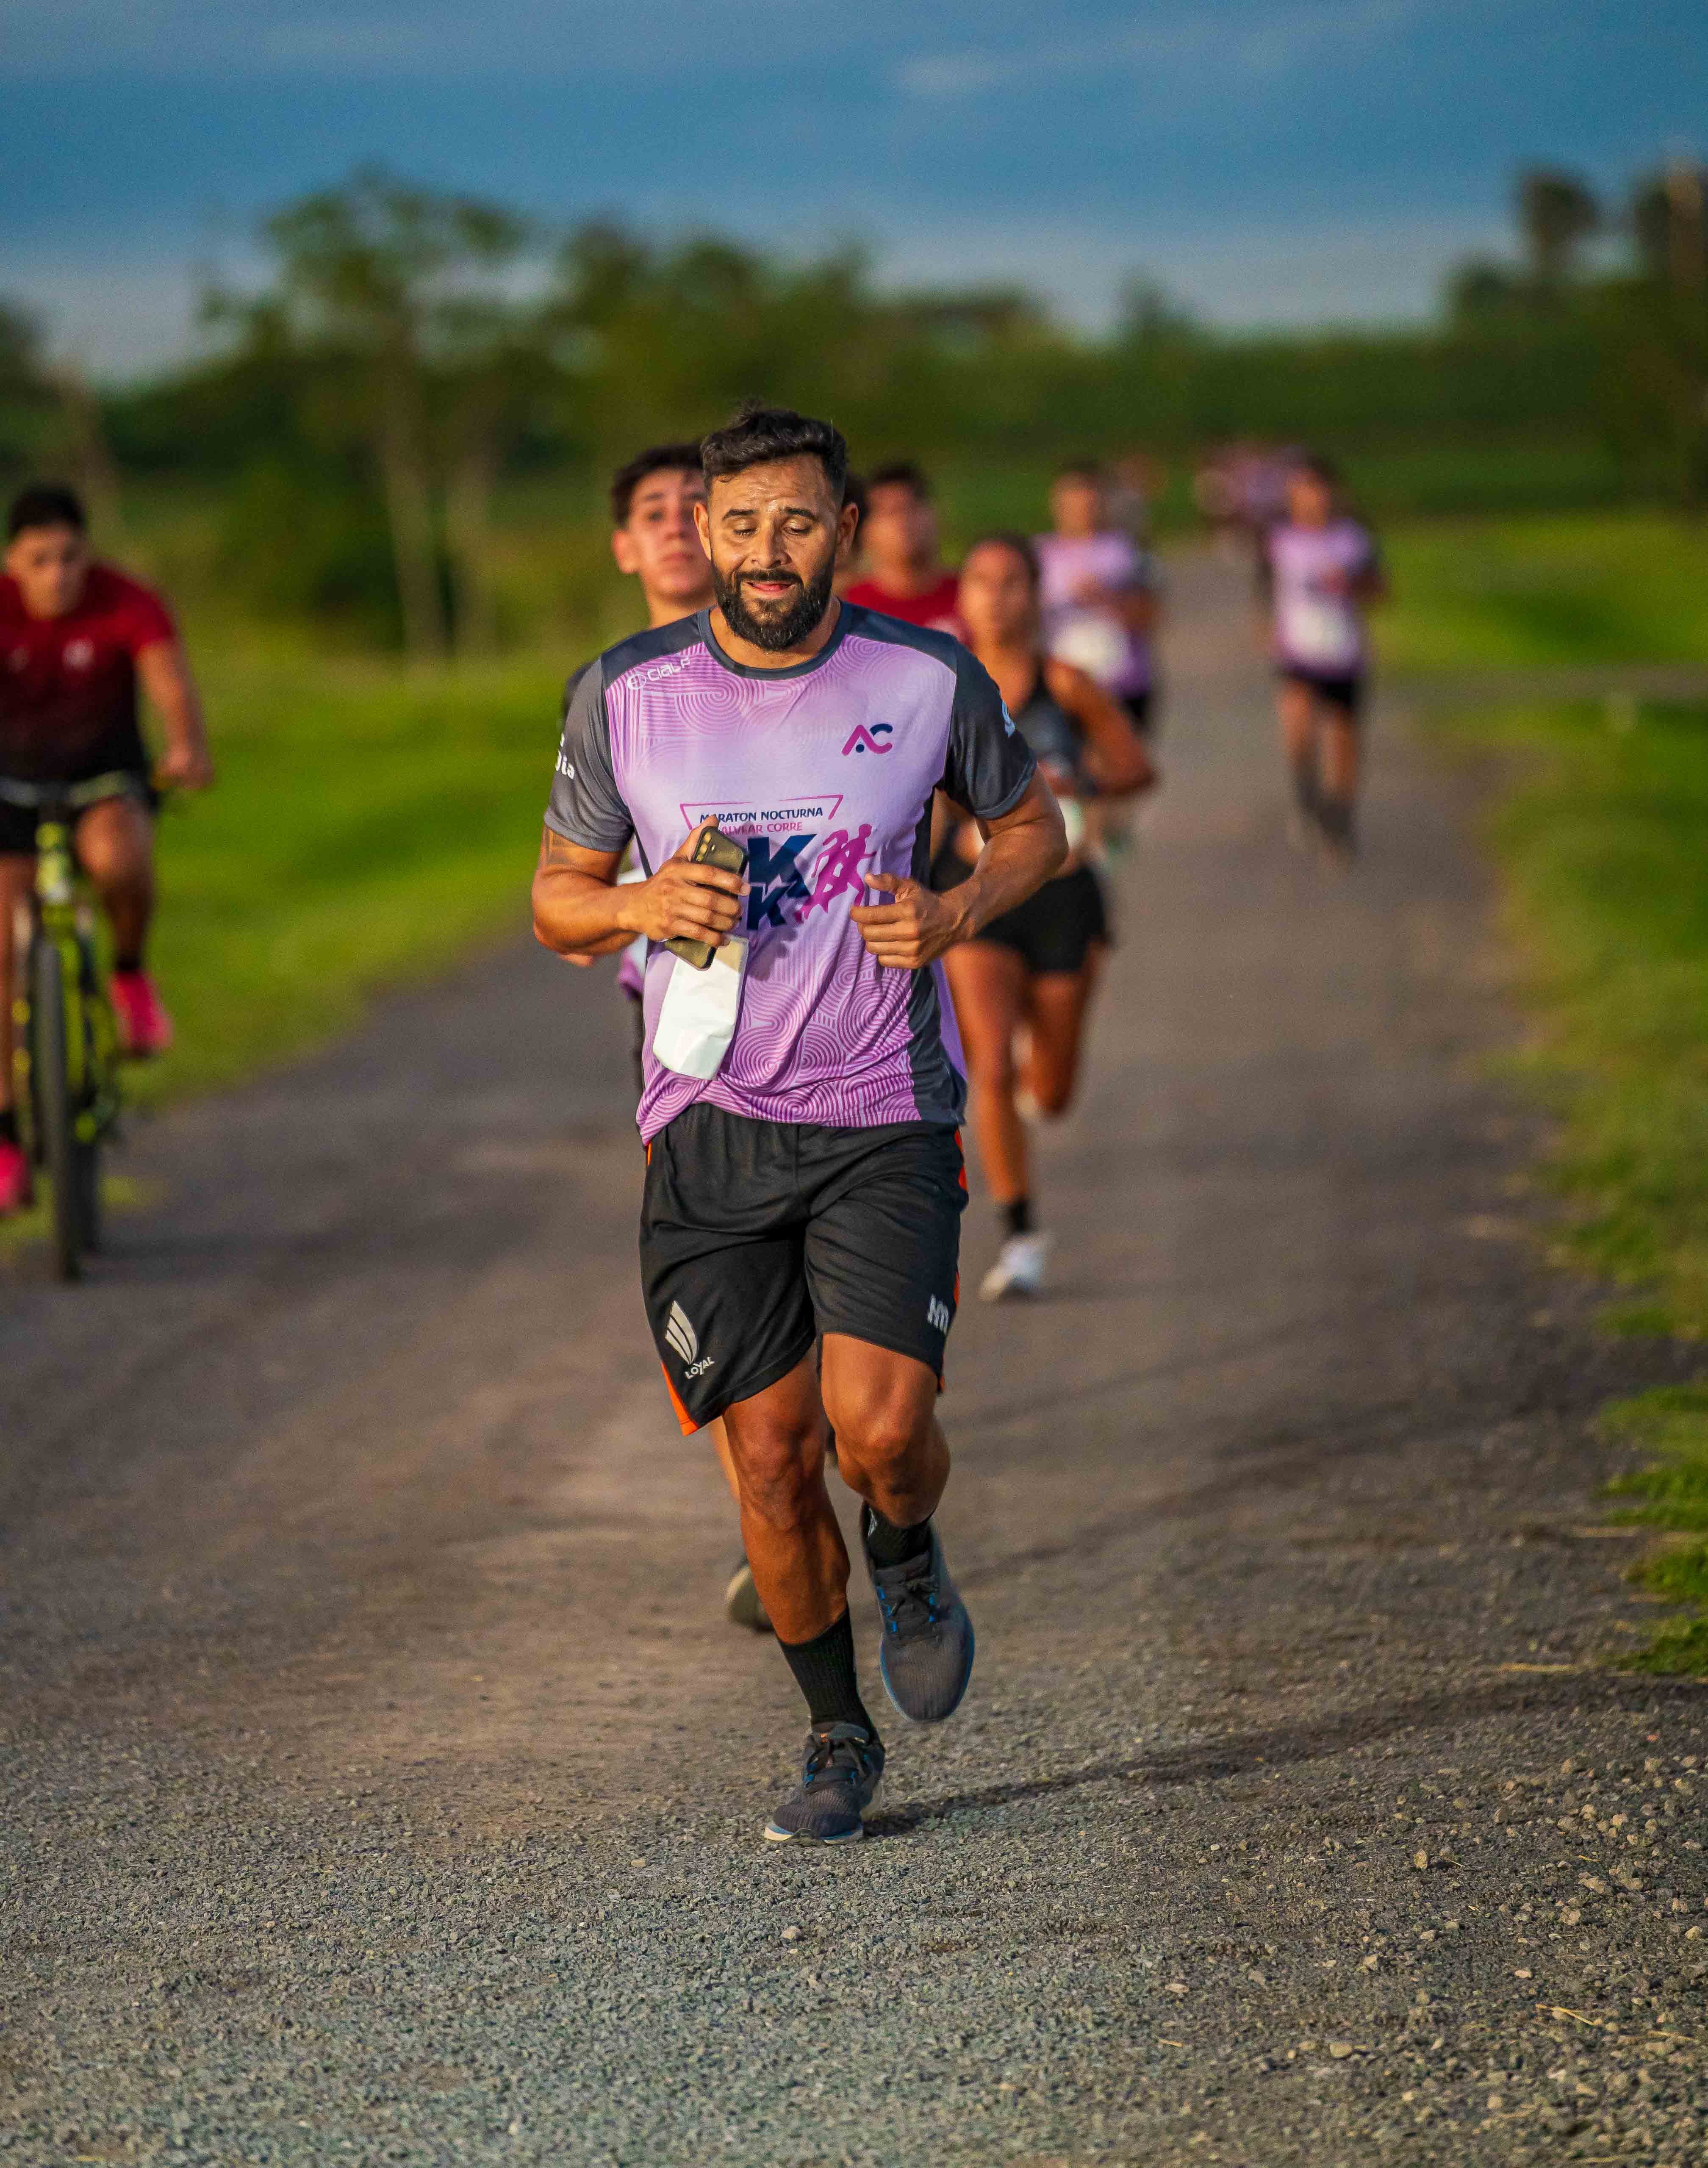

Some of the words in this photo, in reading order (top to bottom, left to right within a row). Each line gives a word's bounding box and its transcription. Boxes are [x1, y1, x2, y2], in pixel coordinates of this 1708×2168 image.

[842, 724, 893, 756] AC
[700, 811, 757, 823] MRATON
[761, 807, 823, 821] NOCTURNA
[766, 822, 803, 833] CORRE
[746, 881, 795, 931] K
[685, 1357, 715, 1380] LOYAL
